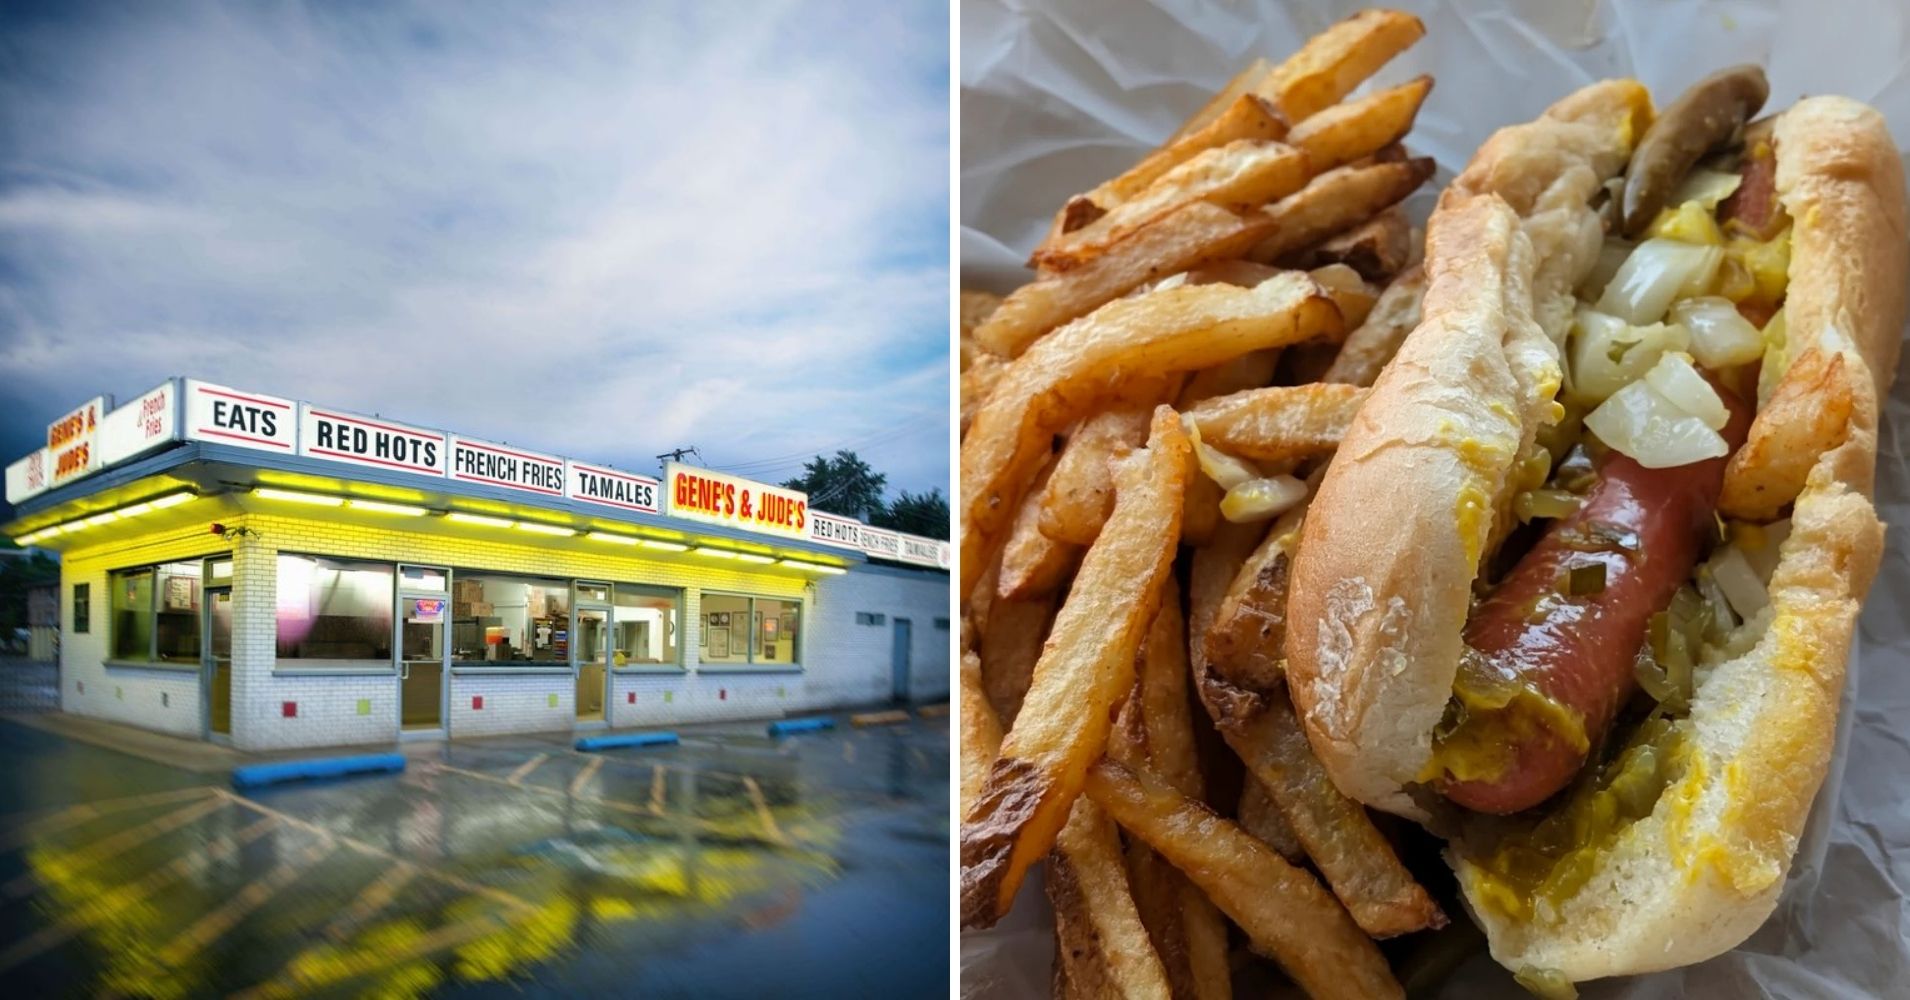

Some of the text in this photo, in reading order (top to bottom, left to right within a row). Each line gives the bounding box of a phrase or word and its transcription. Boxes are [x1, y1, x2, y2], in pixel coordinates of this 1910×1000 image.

[213, 401, 277, 437] EATS
[317, 420, 436, 467] RED HOTS
[455, 448, 562, 491] FRENCH FRIES
[578, 472, 653, 507] TAMALES
[675, 472, 805, 529] GENE'S & JUDE'S
[813, 518, 859, 543] RED HOTS
